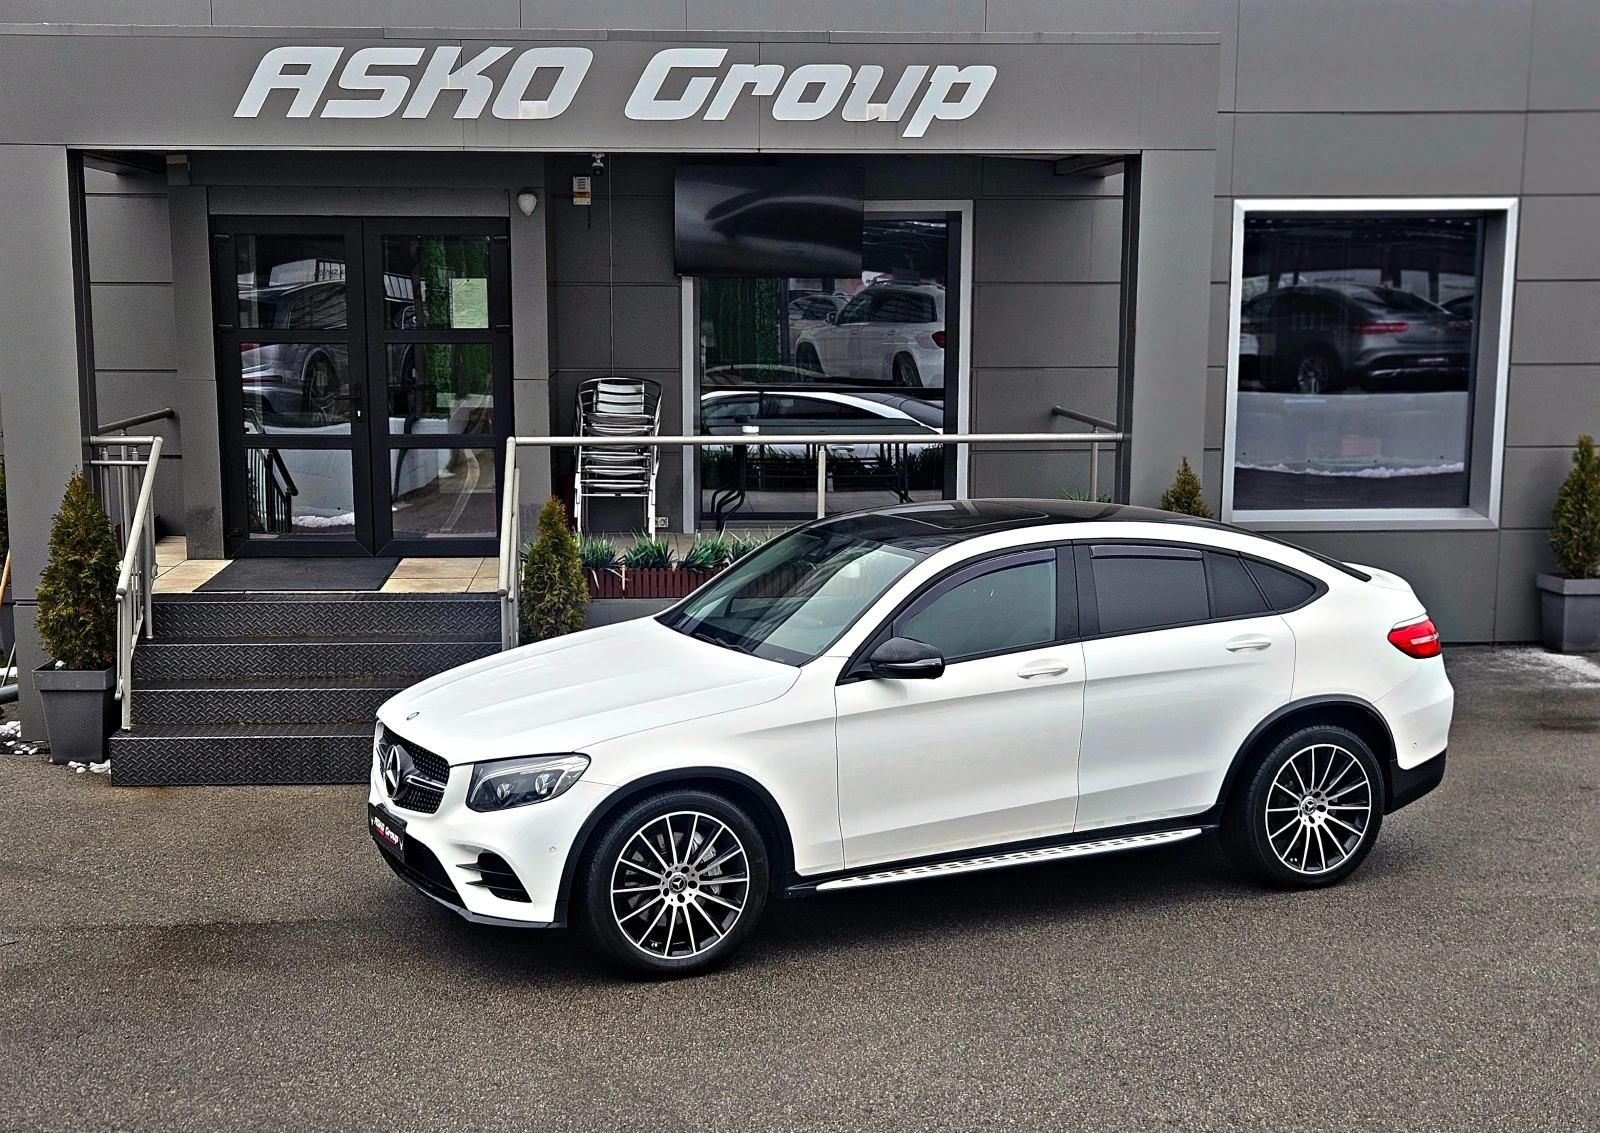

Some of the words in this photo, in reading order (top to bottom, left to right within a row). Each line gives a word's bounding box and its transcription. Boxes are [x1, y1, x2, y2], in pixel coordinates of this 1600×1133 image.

[233, 46, 594, 120] ASKO
[624, 48, 998, 138] Group
[385, 826, 399, 844] Group
